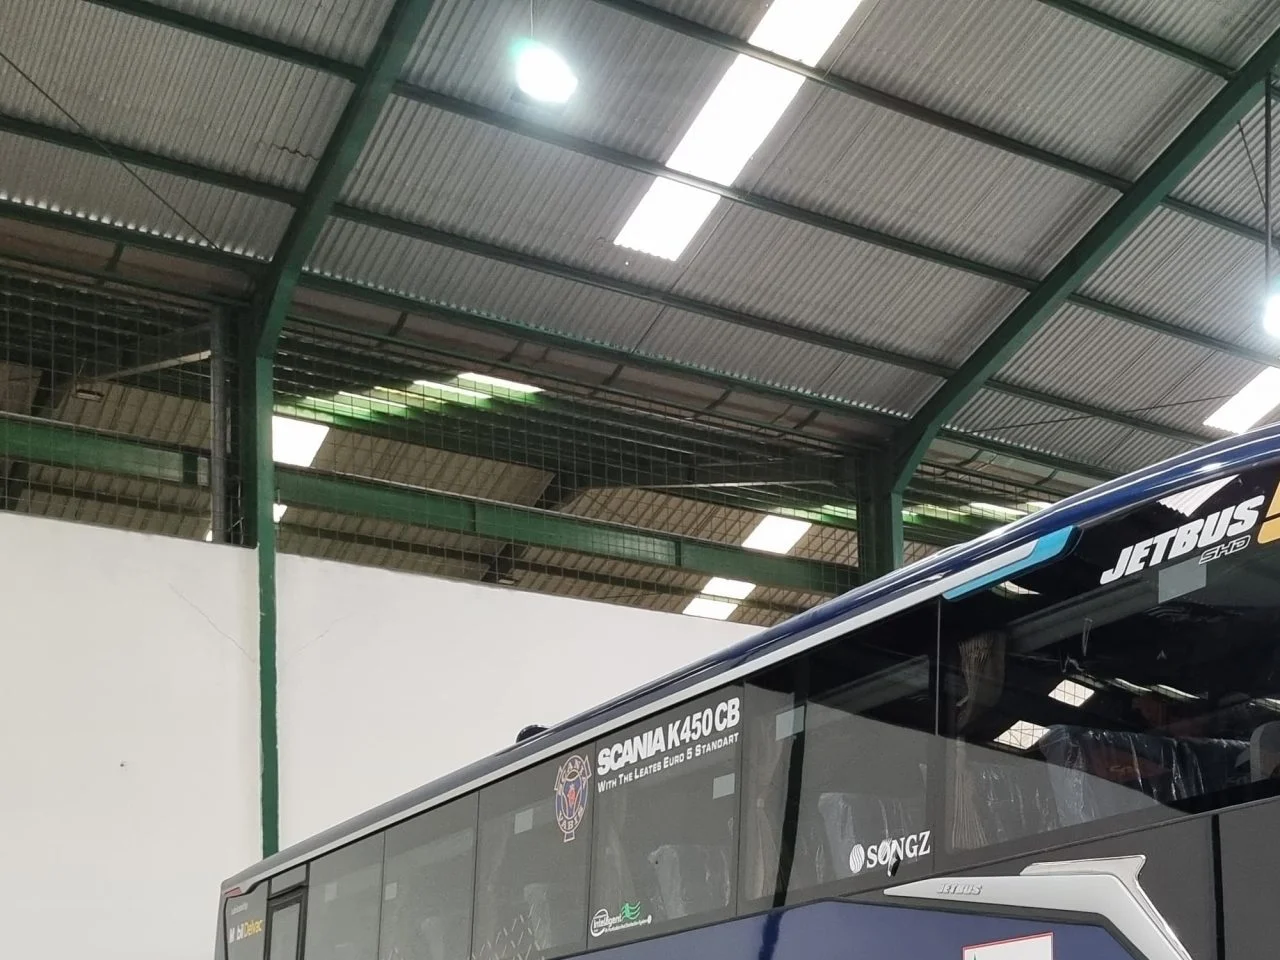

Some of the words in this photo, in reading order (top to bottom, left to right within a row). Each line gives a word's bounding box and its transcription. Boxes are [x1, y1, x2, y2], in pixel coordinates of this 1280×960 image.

[1100, 495, 1266, 586] JETBUS
[1198, 534, 1251, 565] SHD
[597, 727, 665, 776] SCANIA
[866, 830, 931, 869] SONGZ
